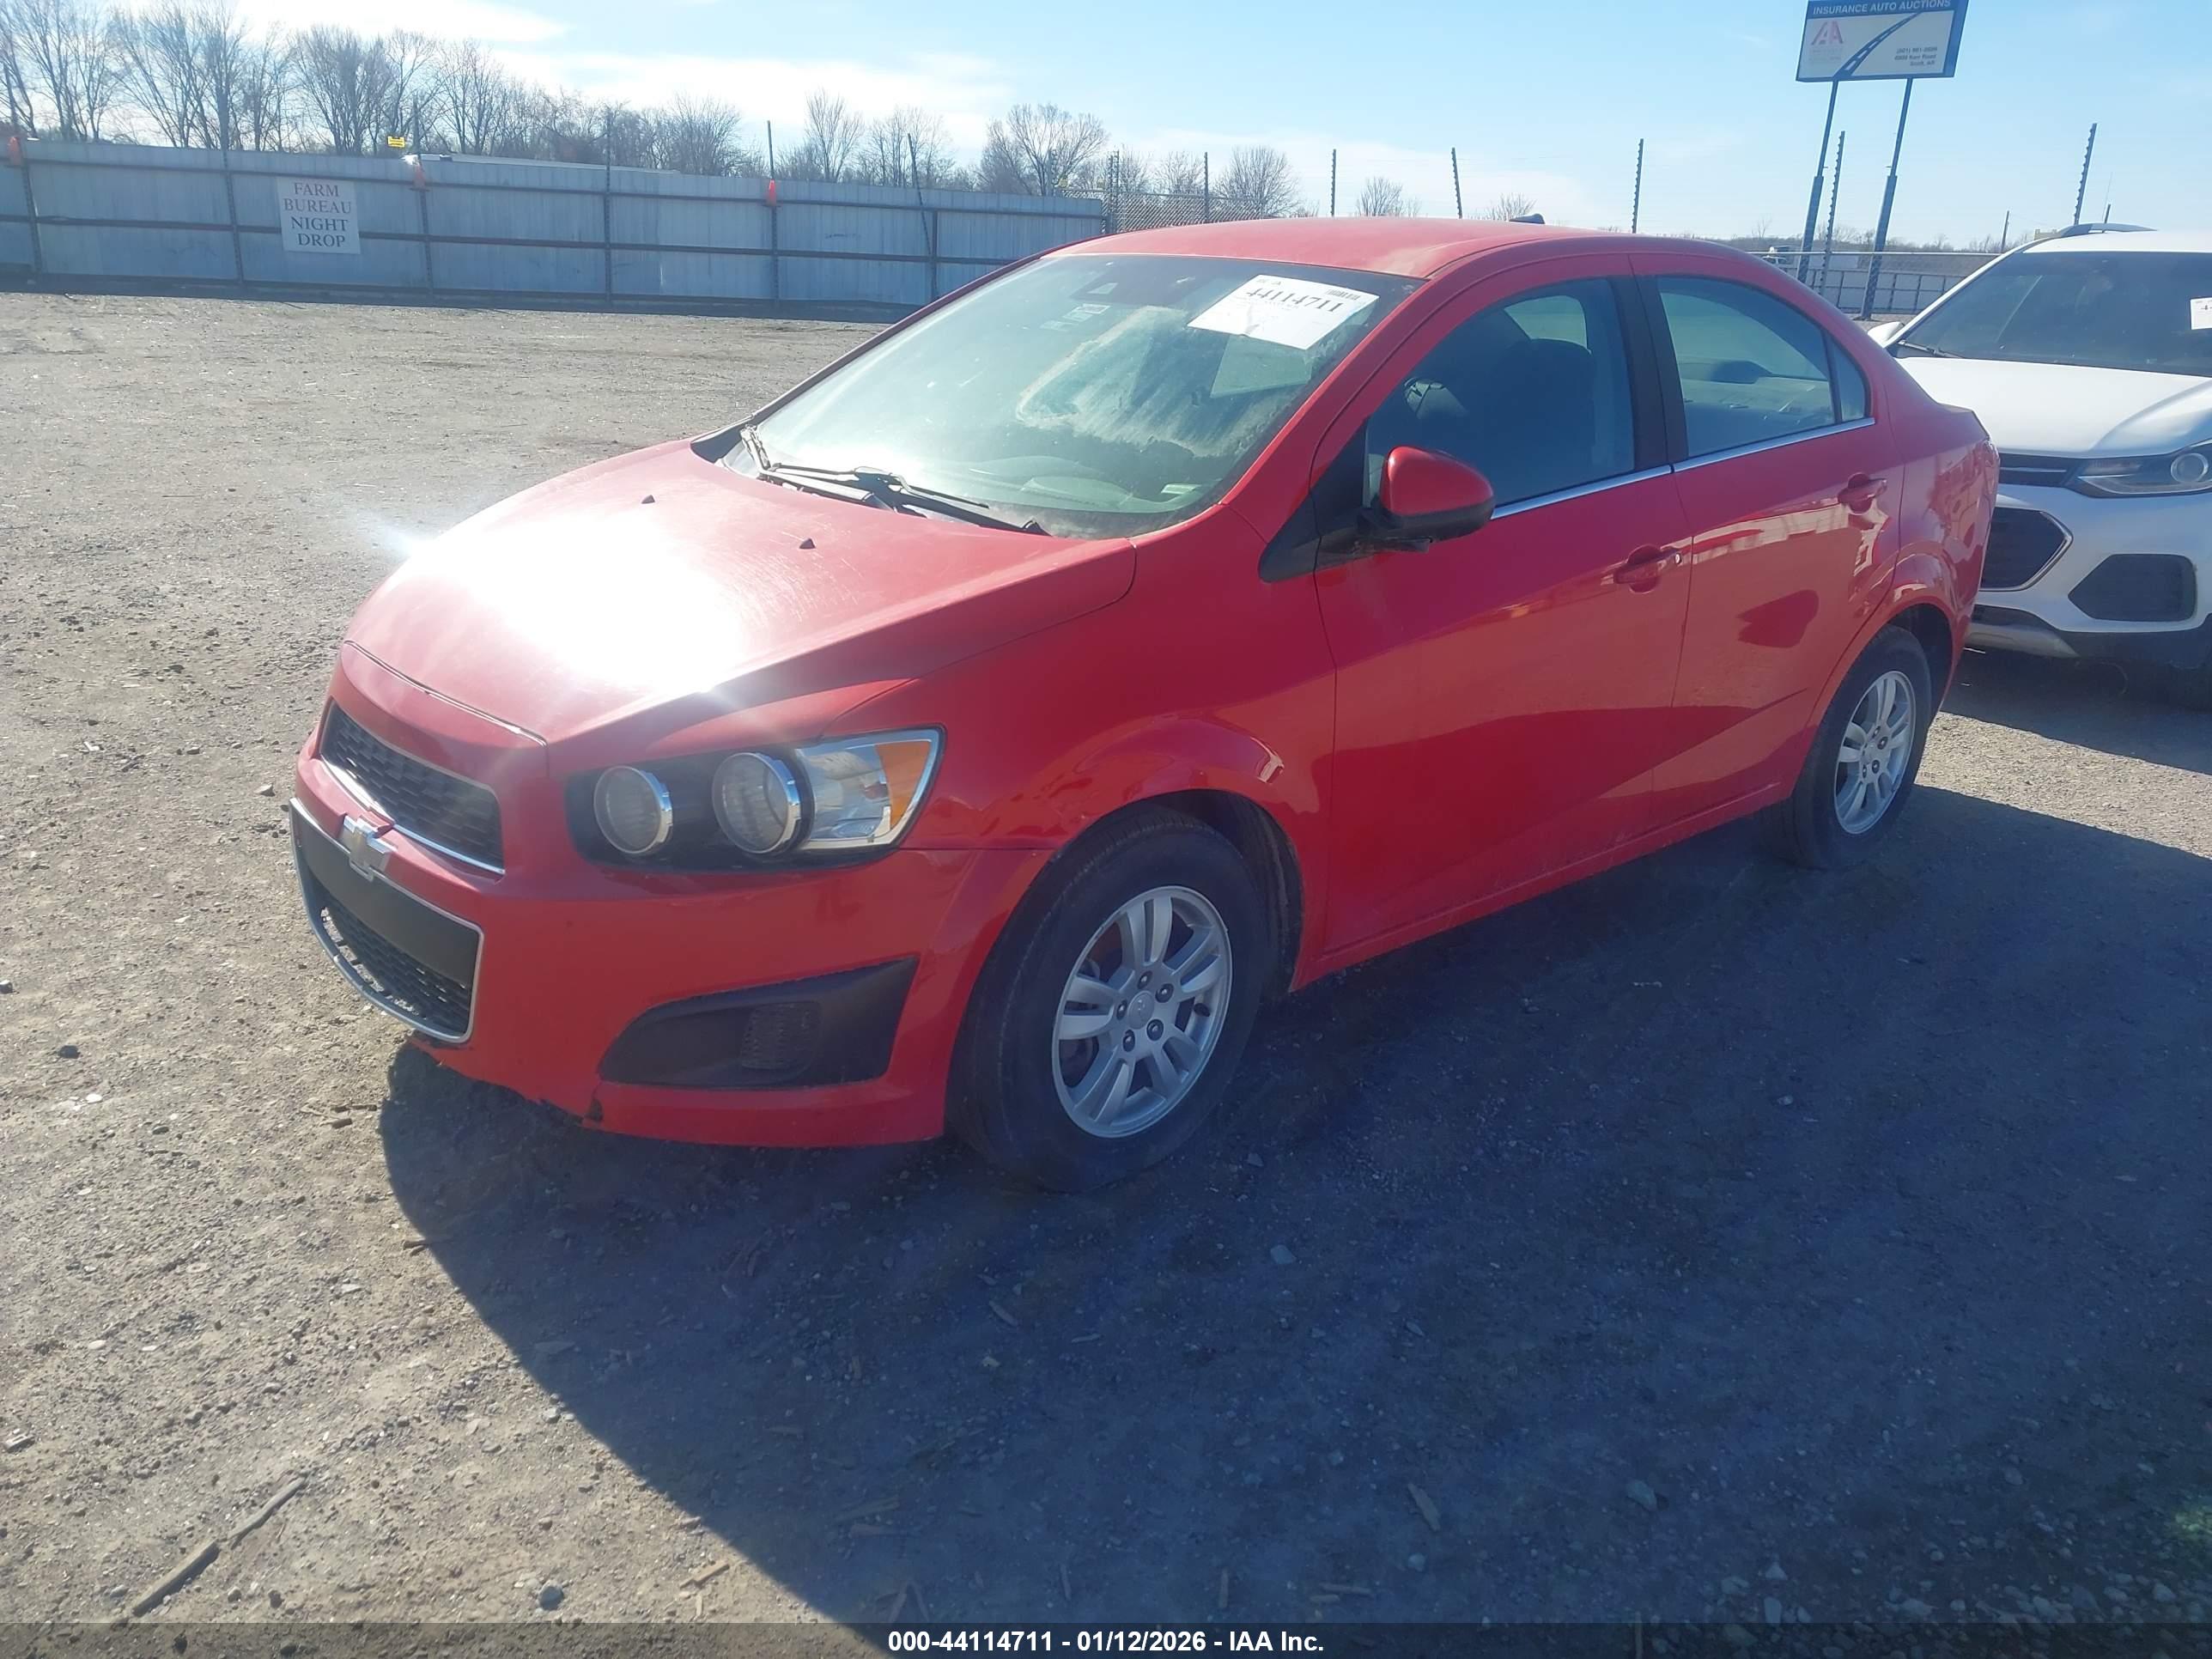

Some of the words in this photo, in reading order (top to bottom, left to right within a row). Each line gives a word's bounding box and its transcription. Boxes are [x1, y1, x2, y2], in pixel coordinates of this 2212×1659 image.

[1813, 3, 1868, 15] INSURANCE
[1869, 2, 1897, 12] AUTO
[1899, 0, 1951, 10] AUCTIONS
[294, 182, 339, 197] FARM
[283, 198, 351, 214] BUREAU
[290, 216, 349, 231] NIGHT
[297, 233, 345, 247] DROP
[1246, 288, 1344, 312] 44114711
